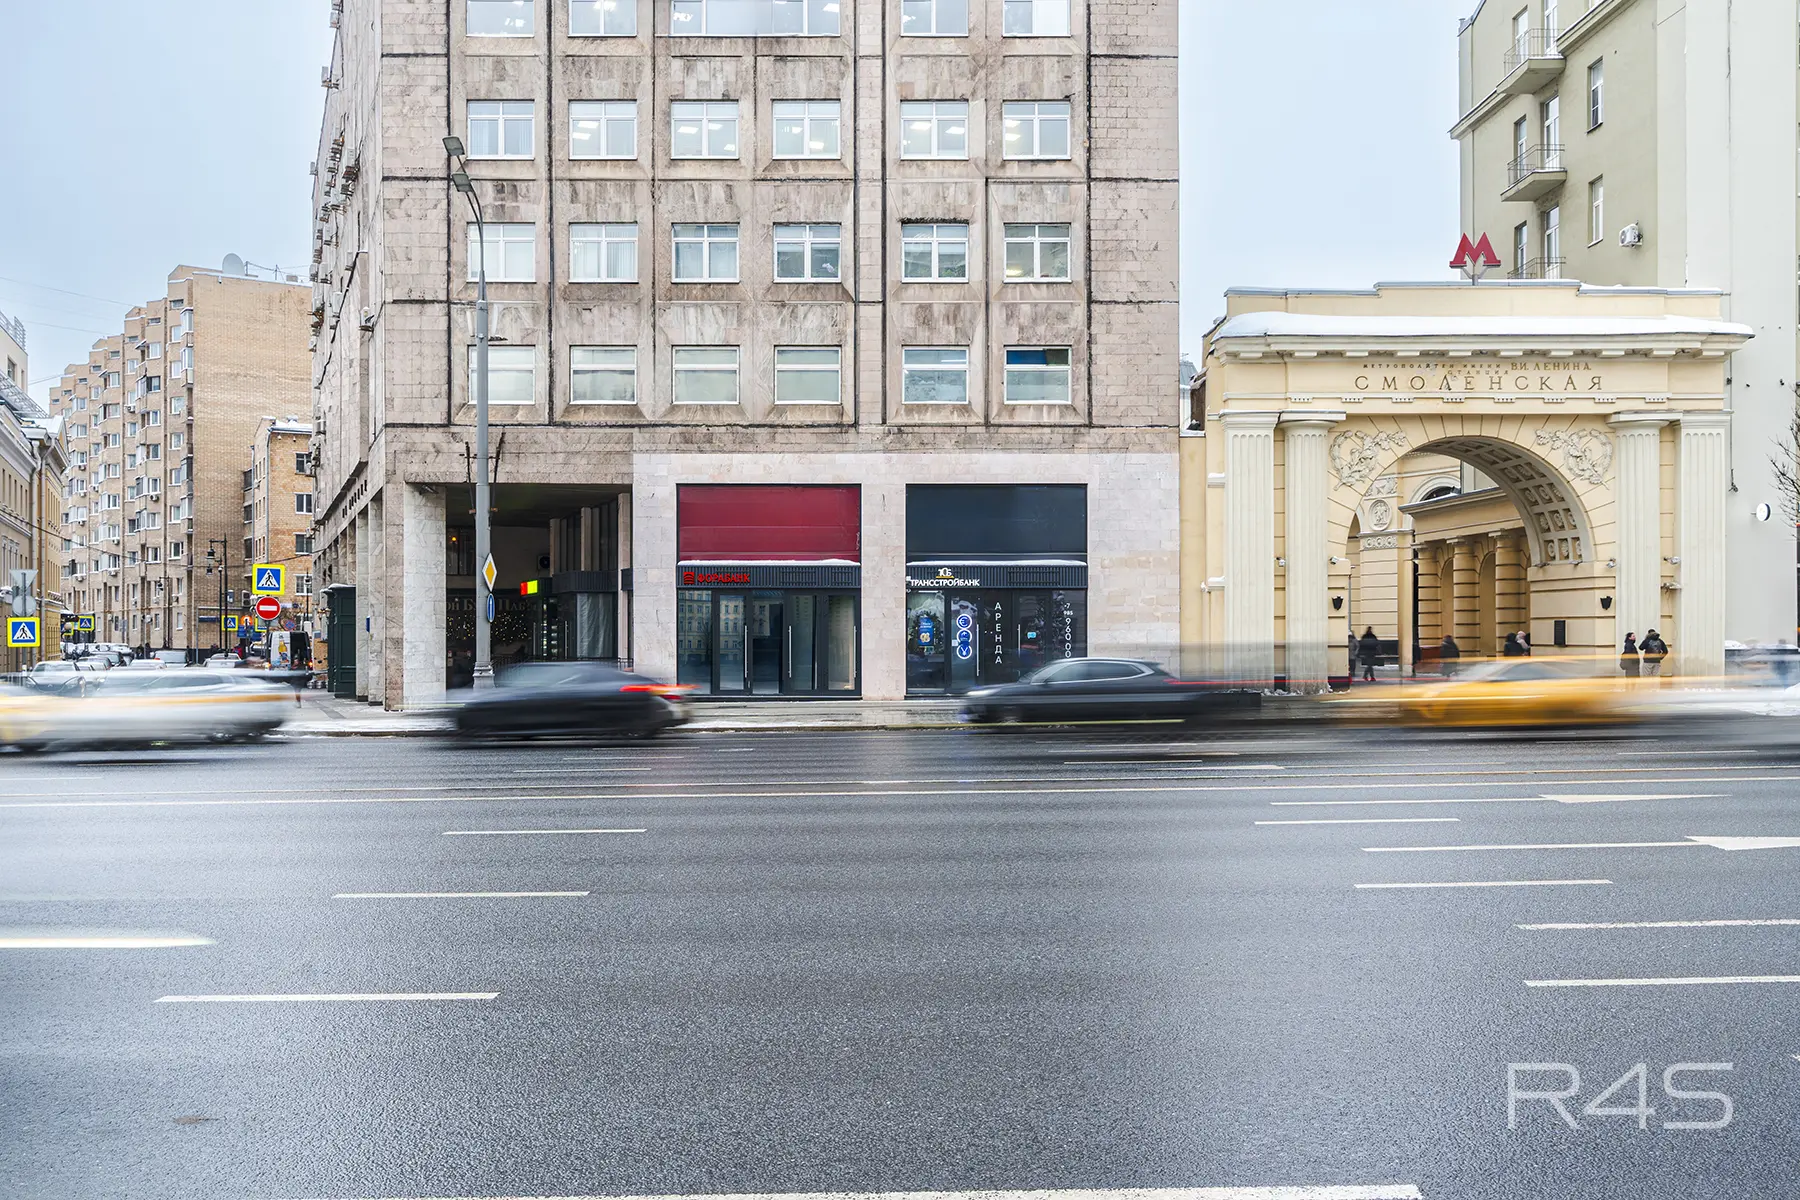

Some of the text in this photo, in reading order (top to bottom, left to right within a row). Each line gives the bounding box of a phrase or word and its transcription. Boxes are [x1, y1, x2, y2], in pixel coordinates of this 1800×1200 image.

[1354, 374, 1602, 391] СМОЛЕНСКАЯ
[697, 573, 751, 583] ФОРАБАНК
[910, 578, 980, 587] ТРАНССТРОЙБАНК
[994, 602, 1003, 664] АРЕНДА
